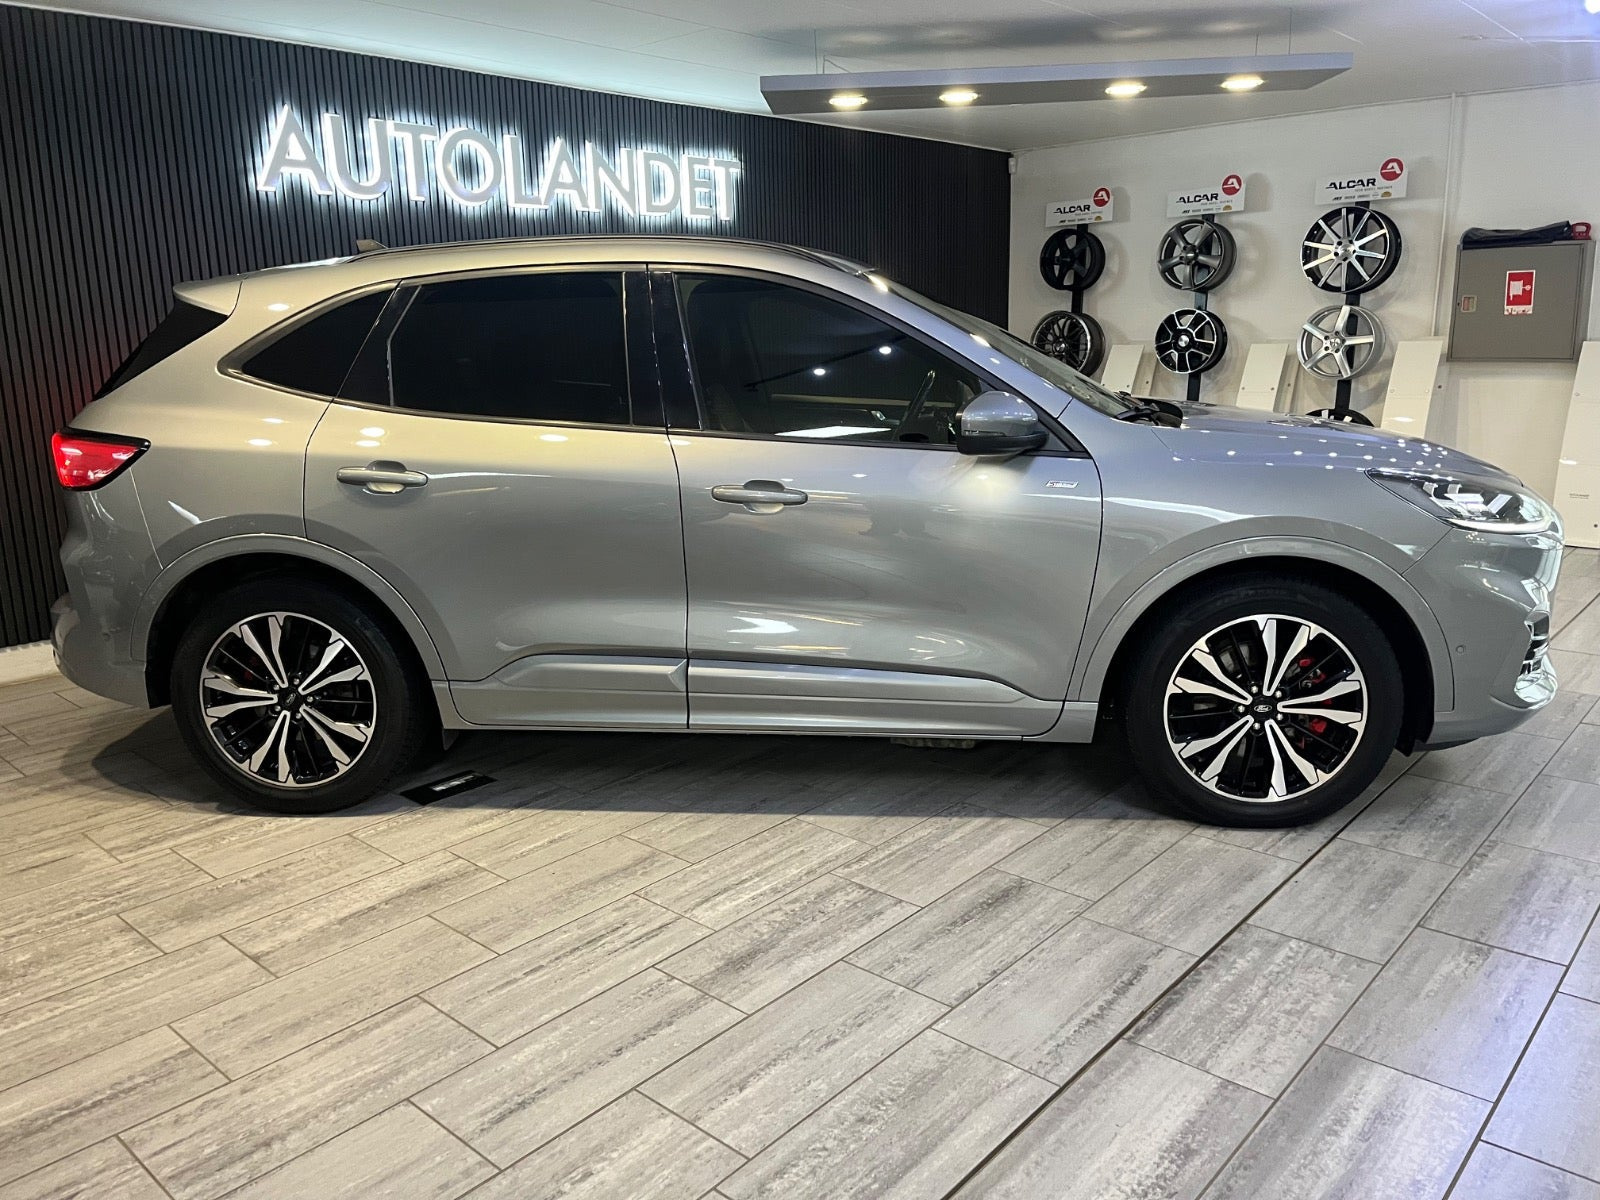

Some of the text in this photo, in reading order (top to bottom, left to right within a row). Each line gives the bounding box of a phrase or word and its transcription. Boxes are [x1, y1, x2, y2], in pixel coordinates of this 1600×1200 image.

[257, 103, 742, 221] AUTOLANDET
[1325, 178, 1377, 190] ALCAR
[1176, 192, 1219, 204] ALCAR
[1053, 204, 1091, 214] ALCAR
